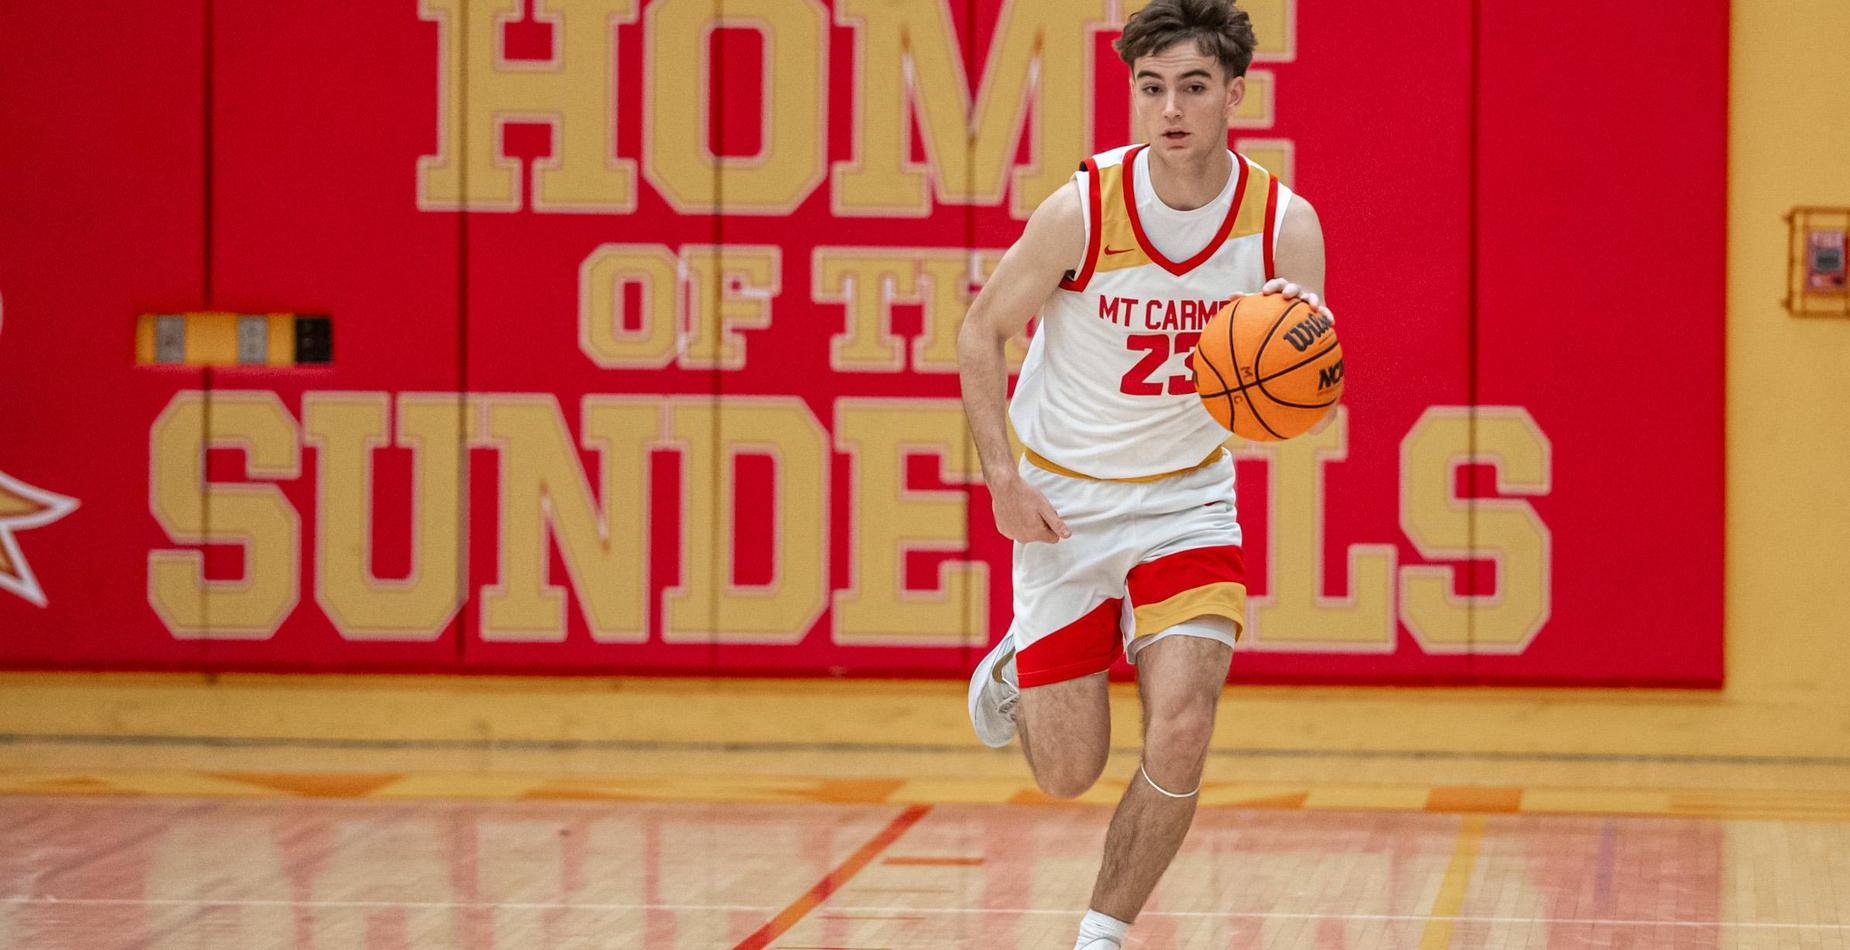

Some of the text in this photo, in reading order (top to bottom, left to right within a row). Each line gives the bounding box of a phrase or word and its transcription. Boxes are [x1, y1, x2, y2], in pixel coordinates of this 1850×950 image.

[578, 242, 1028, 373] OF TH
[1098, 294, 1232, 331] MT CARM
[1318, 358, 1344, 391] NC
[148, 390, 1552, 655] SUNDELS
